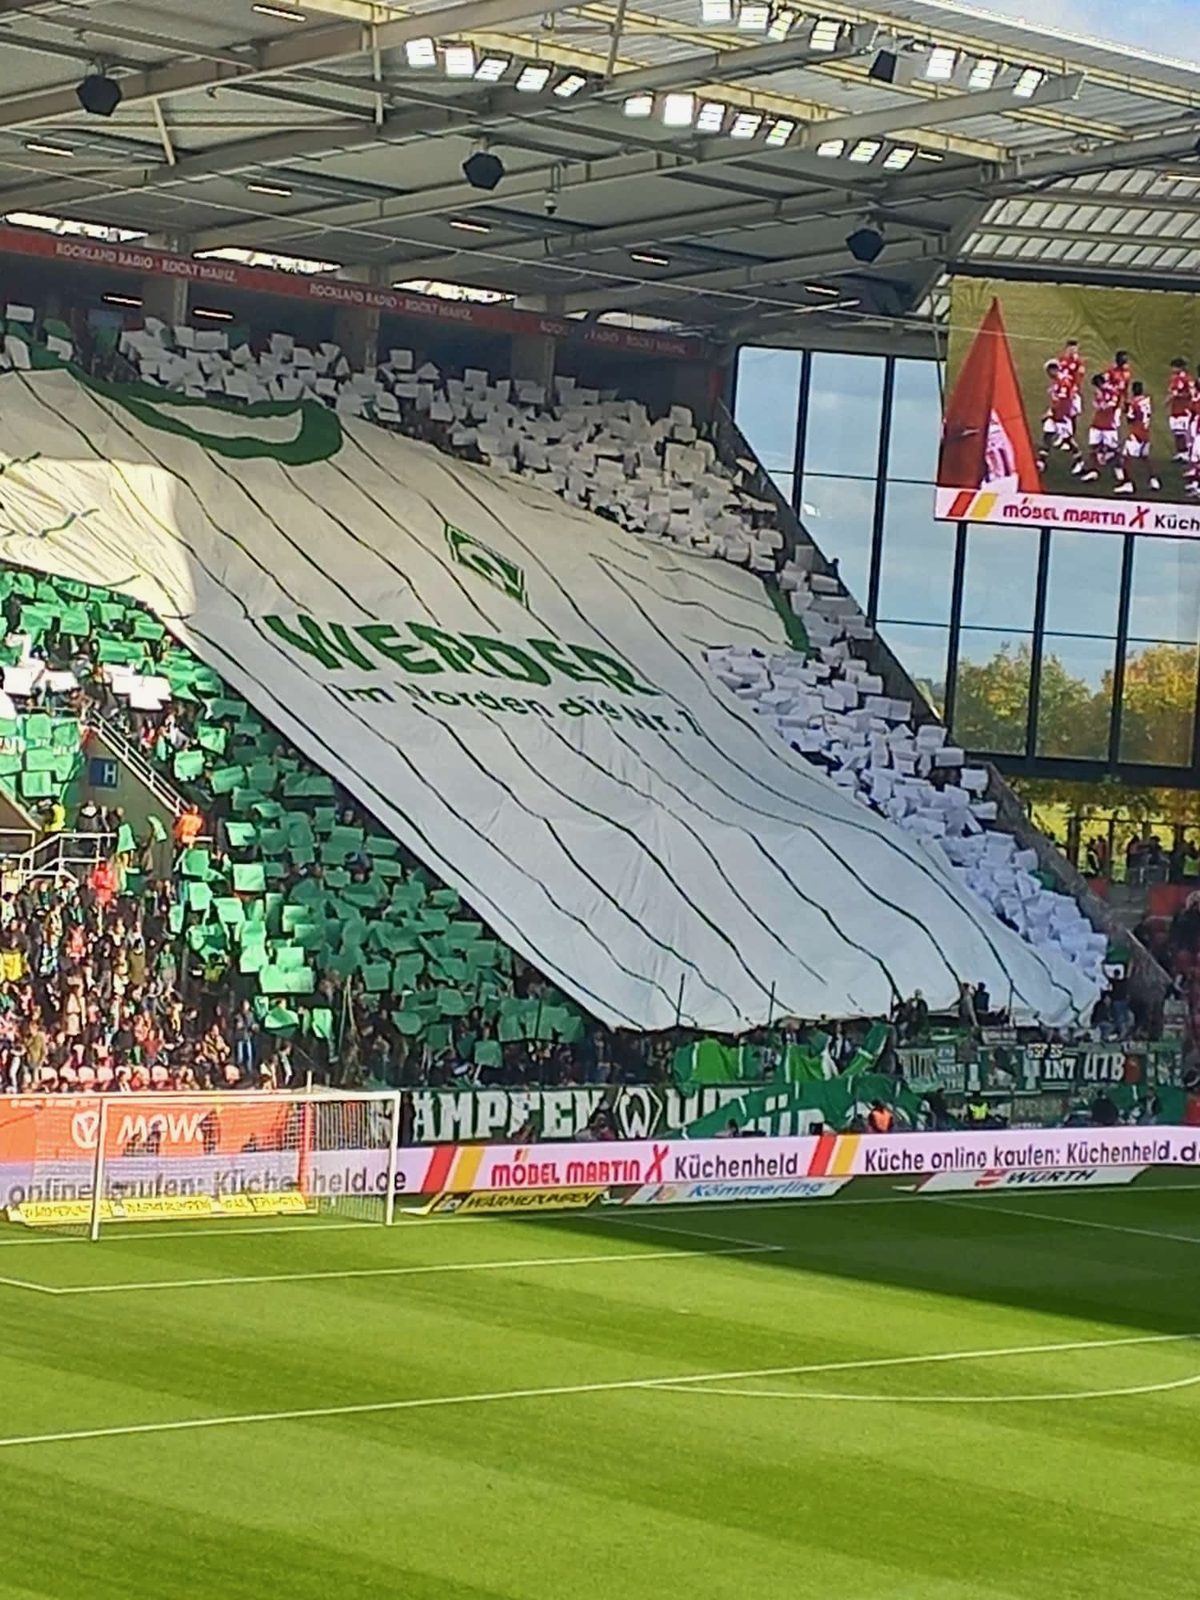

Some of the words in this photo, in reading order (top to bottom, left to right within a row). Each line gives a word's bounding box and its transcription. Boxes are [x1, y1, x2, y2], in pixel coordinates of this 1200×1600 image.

[118, 253, 153, 269] RADIO
[1063, 508, 1126, 526] MARTIN
[263, 613, 664, 697] WERDER
[394, 681, 554, 718] Norden
[558, 695, 623, 721] die
[103, 763, 117, 785] H
[491, 1148, 560, 1187] MÖBEL
[566, 1159, 641, 1184] MARTIN
[675, 1153, 799, 1180] Küchenheld
[865, 1147, 924, 1172] Küche
[931, 1146, 987, 1169] online
[994, 1144, 1060, 1167] kaufen:
[1066, 1140, 1200, 1165] Küchenheld.d
